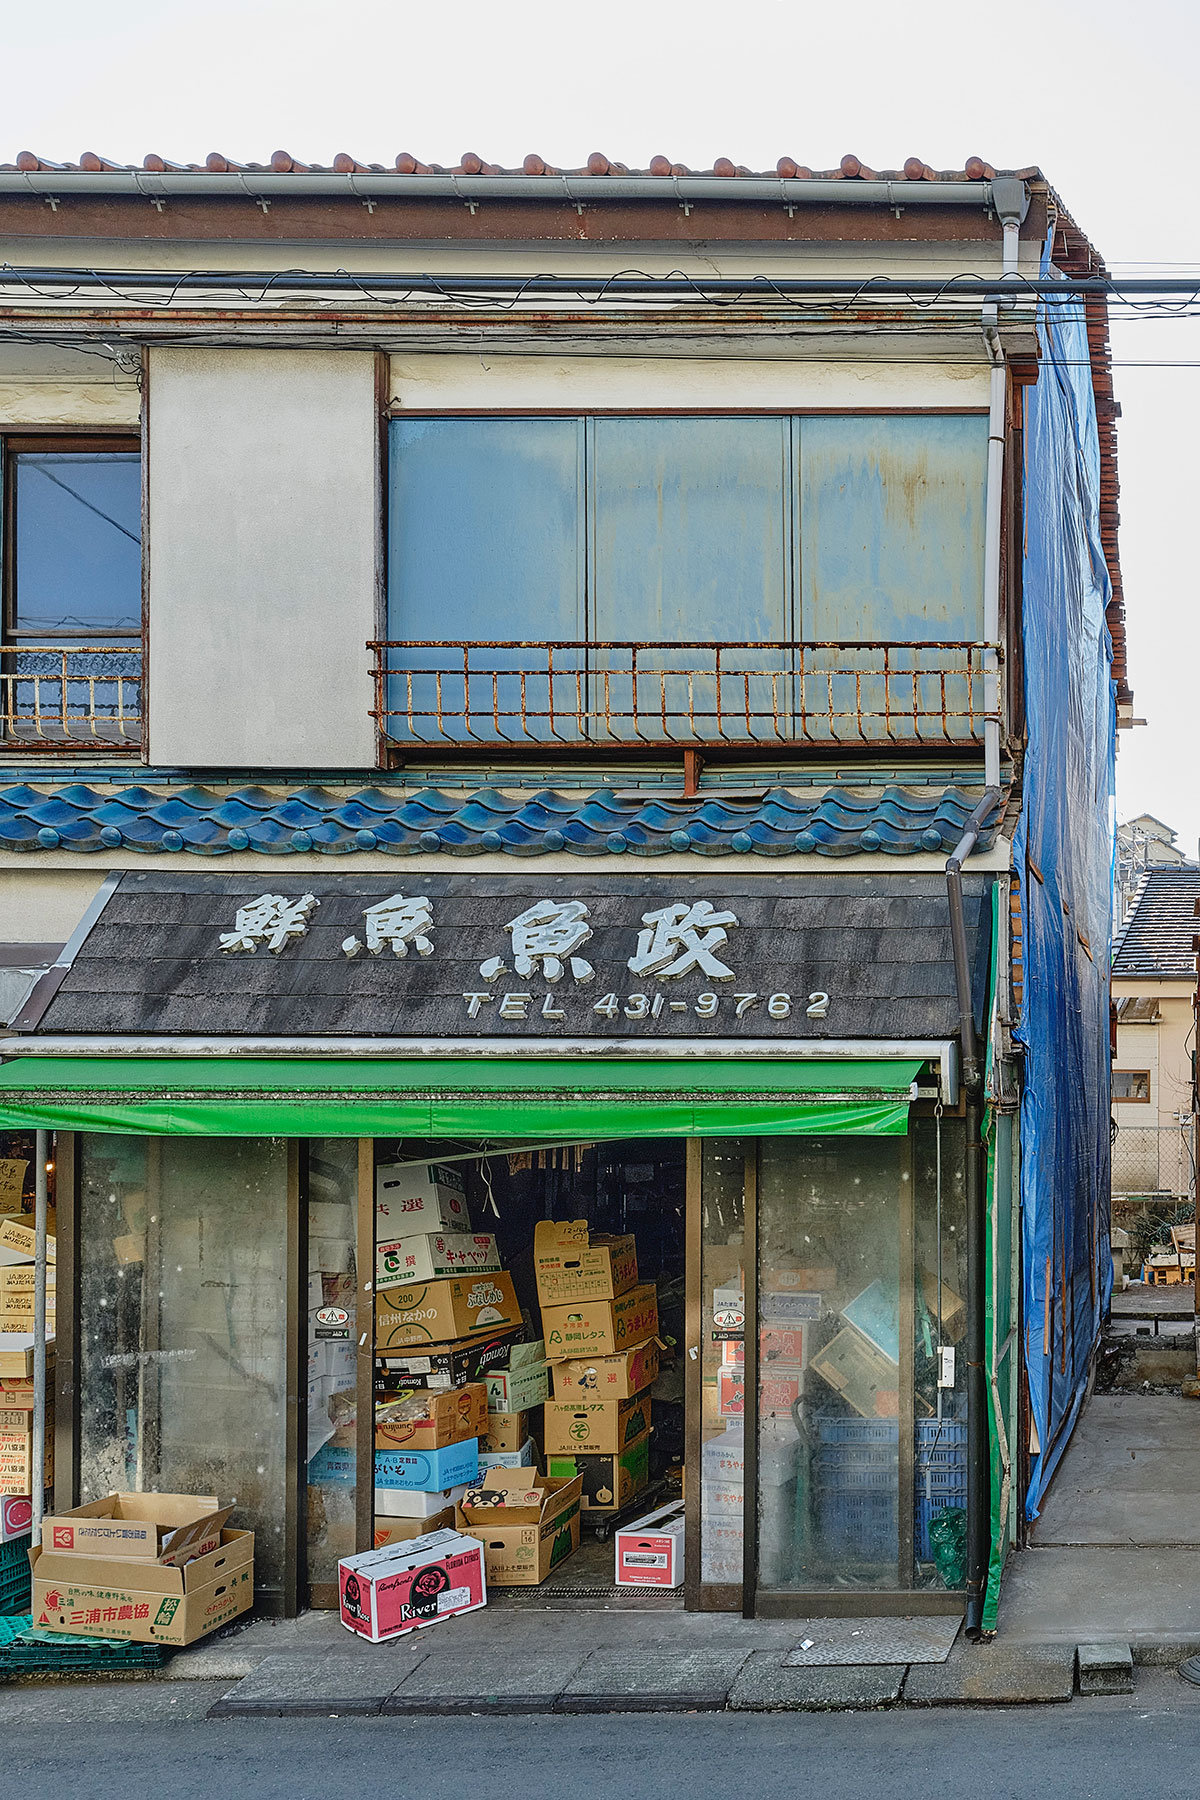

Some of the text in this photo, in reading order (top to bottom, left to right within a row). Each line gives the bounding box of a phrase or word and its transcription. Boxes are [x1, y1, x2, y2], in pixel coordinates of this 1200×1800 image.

[217, 893, 739, 984] 鮮魚 魚政
[463, 991, 831, 1019] TEL 431-9762
[446, 1249, 488, 1264] キャベツ
[398, 1294, 413, 1304] 200
[379, 1308, 438, 1327] 信州なかの
[565, 1331, 606, 1341] 静岡レタス
[446, 1553, 479, 1570] FLORIDA CITRUS
[58, 1598, 75, 1607] 三浦
[342, 1593, 370, 1623] River Rose
[400, 1602, 437, 1622] River
[69, 1603, 150, 1625] 三浦市農協
